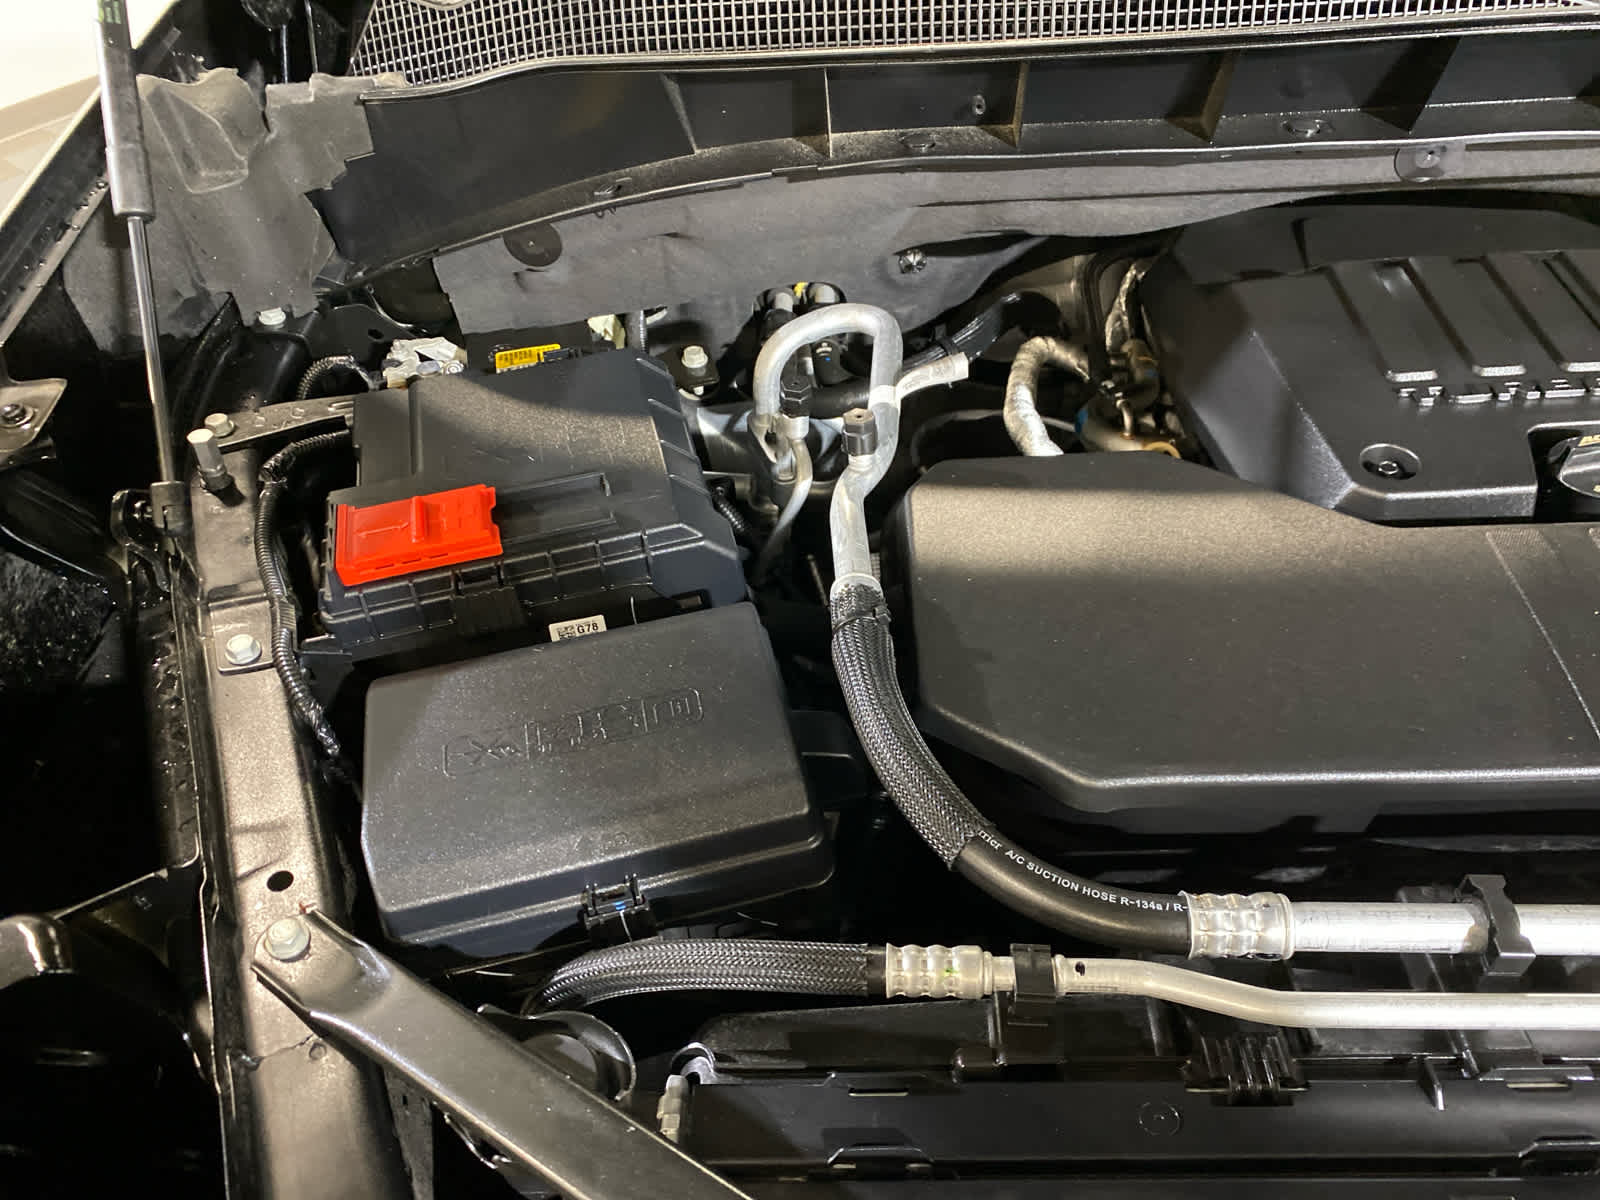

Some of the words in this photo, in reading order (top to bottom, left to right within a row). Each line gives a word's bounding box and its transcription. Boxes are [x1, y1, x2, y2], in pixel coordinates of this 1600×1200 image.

[577, 622, 599, 634] G78
[1005, 849, 1025, 865] A/C
[1026, 861, 1080, 892] SUCTION
[1082, 886, 1117, 903] HOSE
[1120, 896, 1163, 911] R-134a
